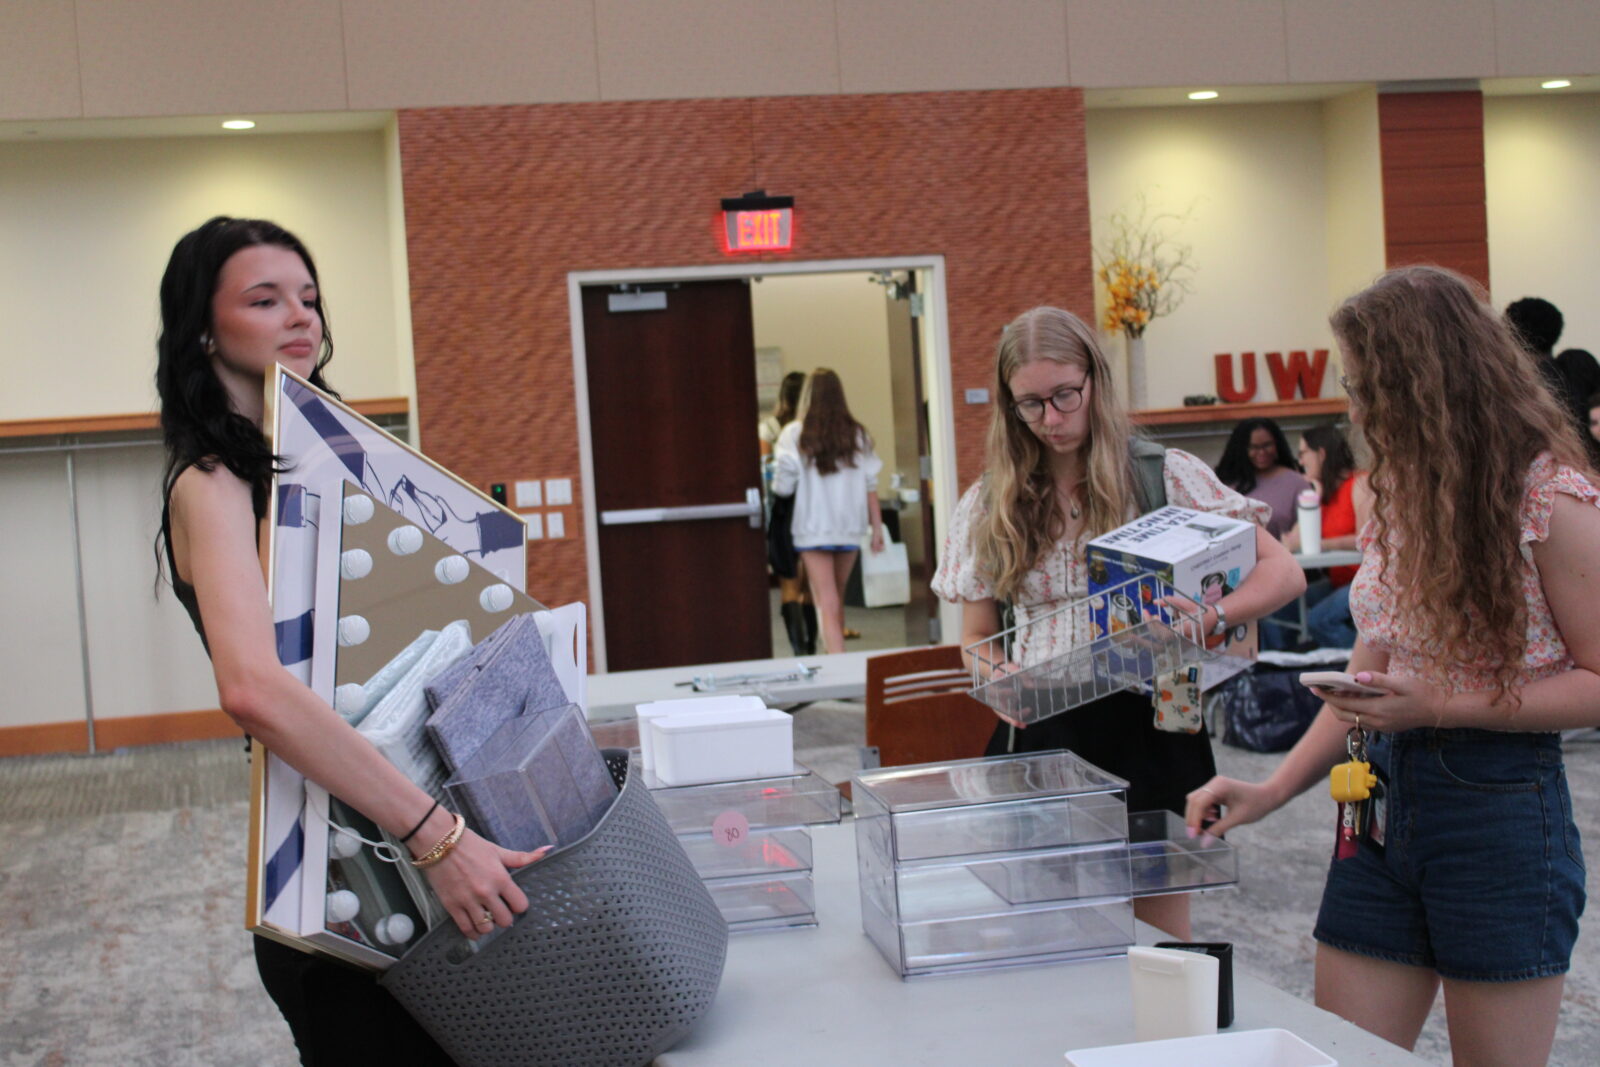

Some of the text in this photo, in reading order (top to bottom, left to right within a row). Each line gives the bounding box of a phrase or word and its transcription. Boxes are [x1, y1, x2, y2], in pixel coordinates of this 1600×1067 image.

[740, 213, 781, 246] EXIT
[1214, 349, 1329, 403] UW
[1100, 507, 1181, 544] IN NO TIME
[1128, 512, 1198, 543] TEA TIME
